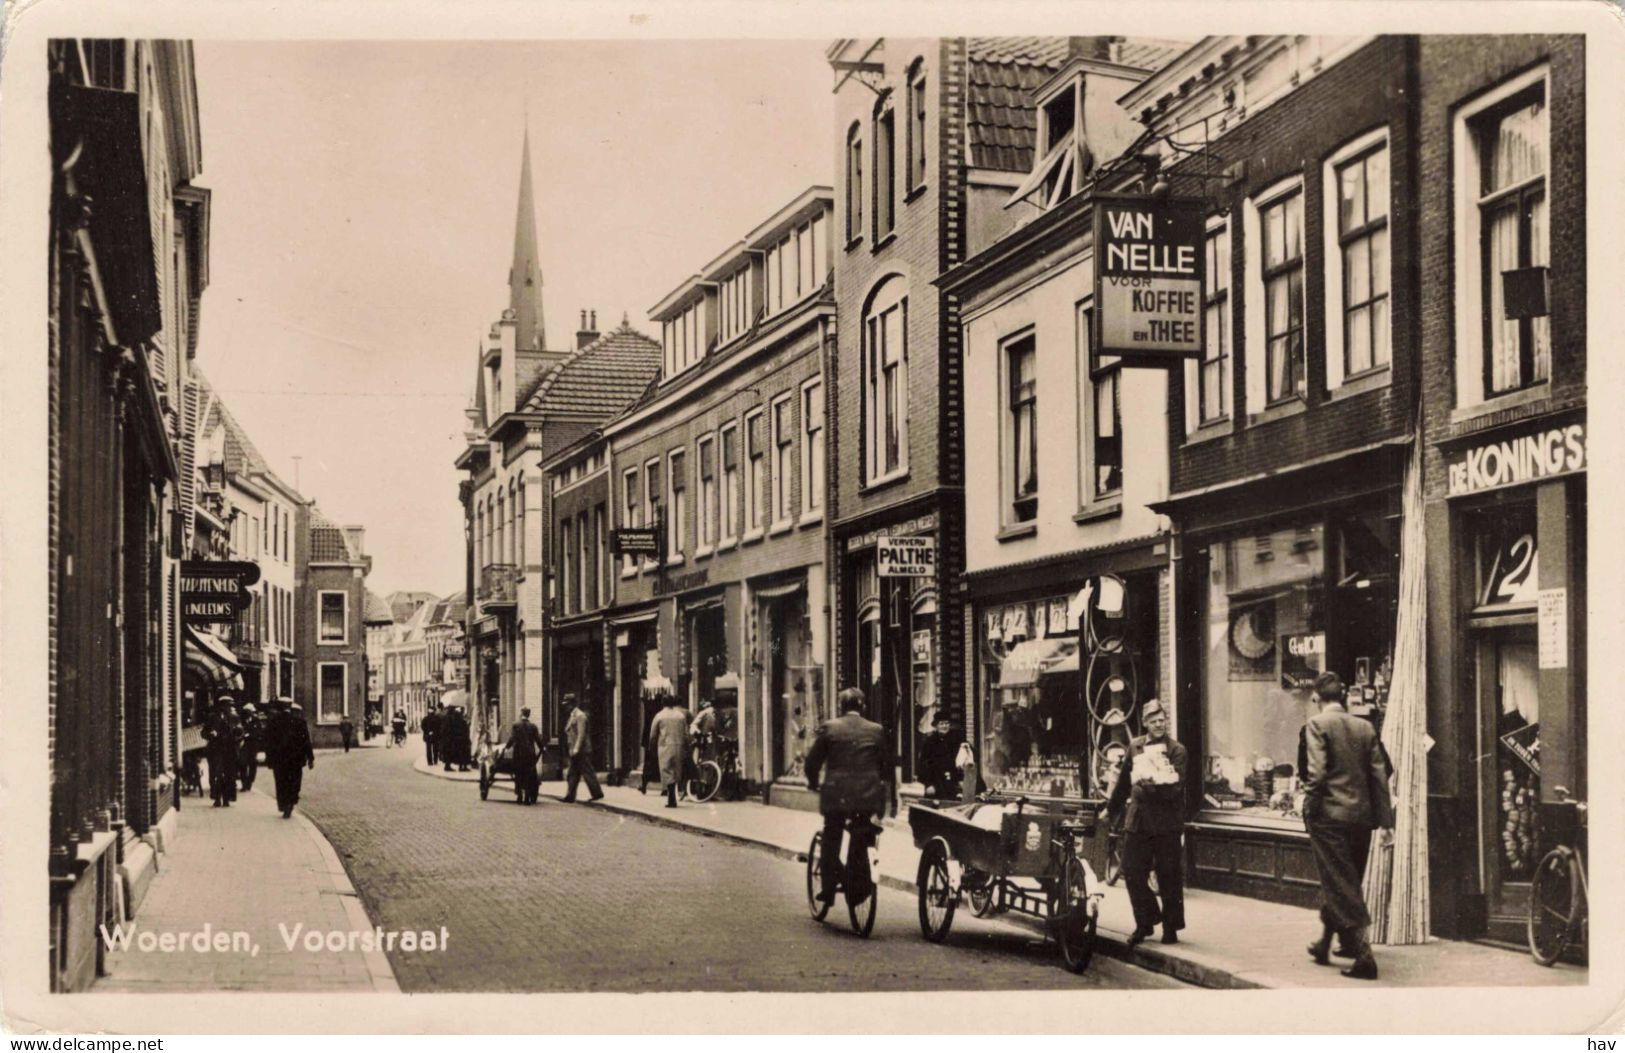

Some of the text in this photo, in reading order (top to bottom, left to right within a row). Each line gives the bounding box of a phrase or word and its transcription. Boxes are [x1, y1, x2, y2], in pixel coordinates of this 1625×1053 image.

[1108, 211, 1153, 239] VAN
[1108, 243, 1194, 272] NELLE
[1110, 277, 1152, 287] VOOR
[1133, 290, 1194, 314] KOFFIE
[1133, 320, 1194, 343] EN THEE
[880, 548, 933, 565] PALTHE
[888, 566, 926, 574] ALMELO
